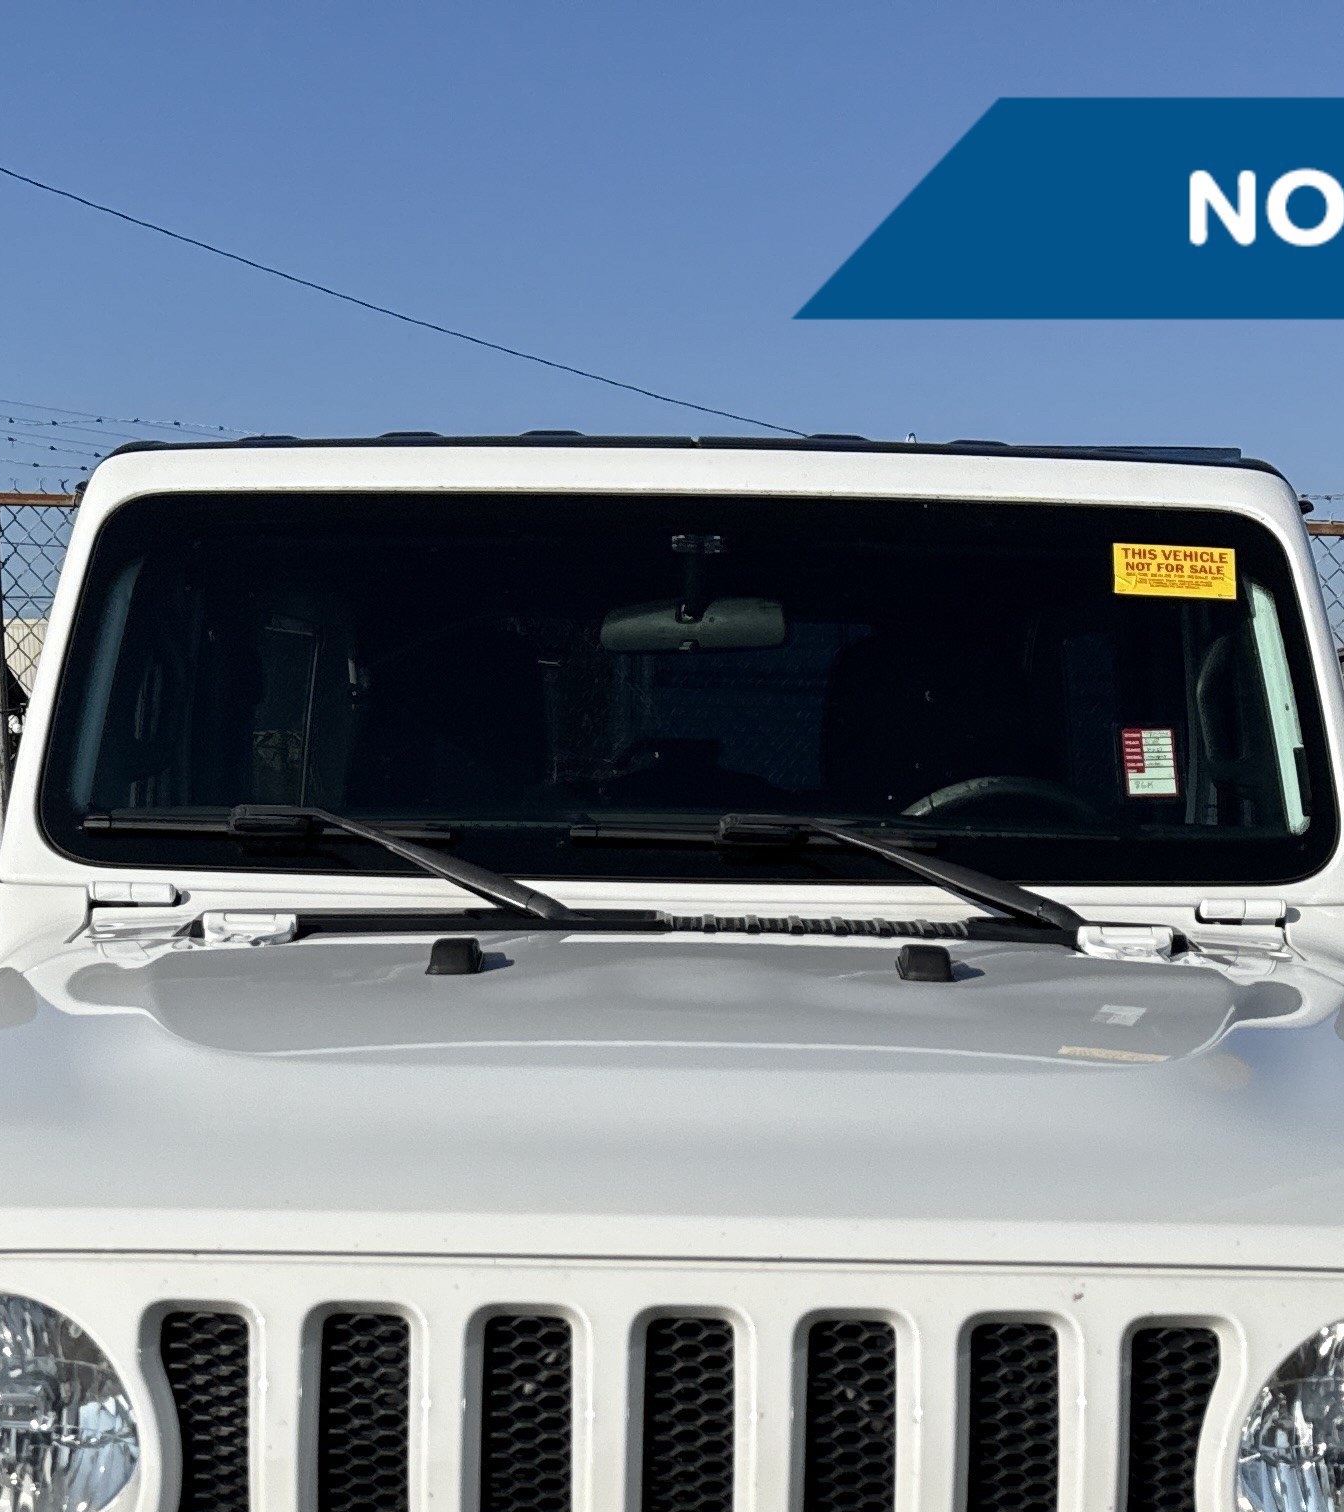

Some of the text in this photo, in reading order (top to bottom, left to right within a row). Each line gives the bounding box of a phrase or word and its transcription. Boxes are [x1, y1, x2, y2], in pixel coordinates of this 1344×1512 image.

[1121, 547, 1229, 564] THIS VEHICLE
[1125, 561, 1225, 576] NOT FOR SALE
